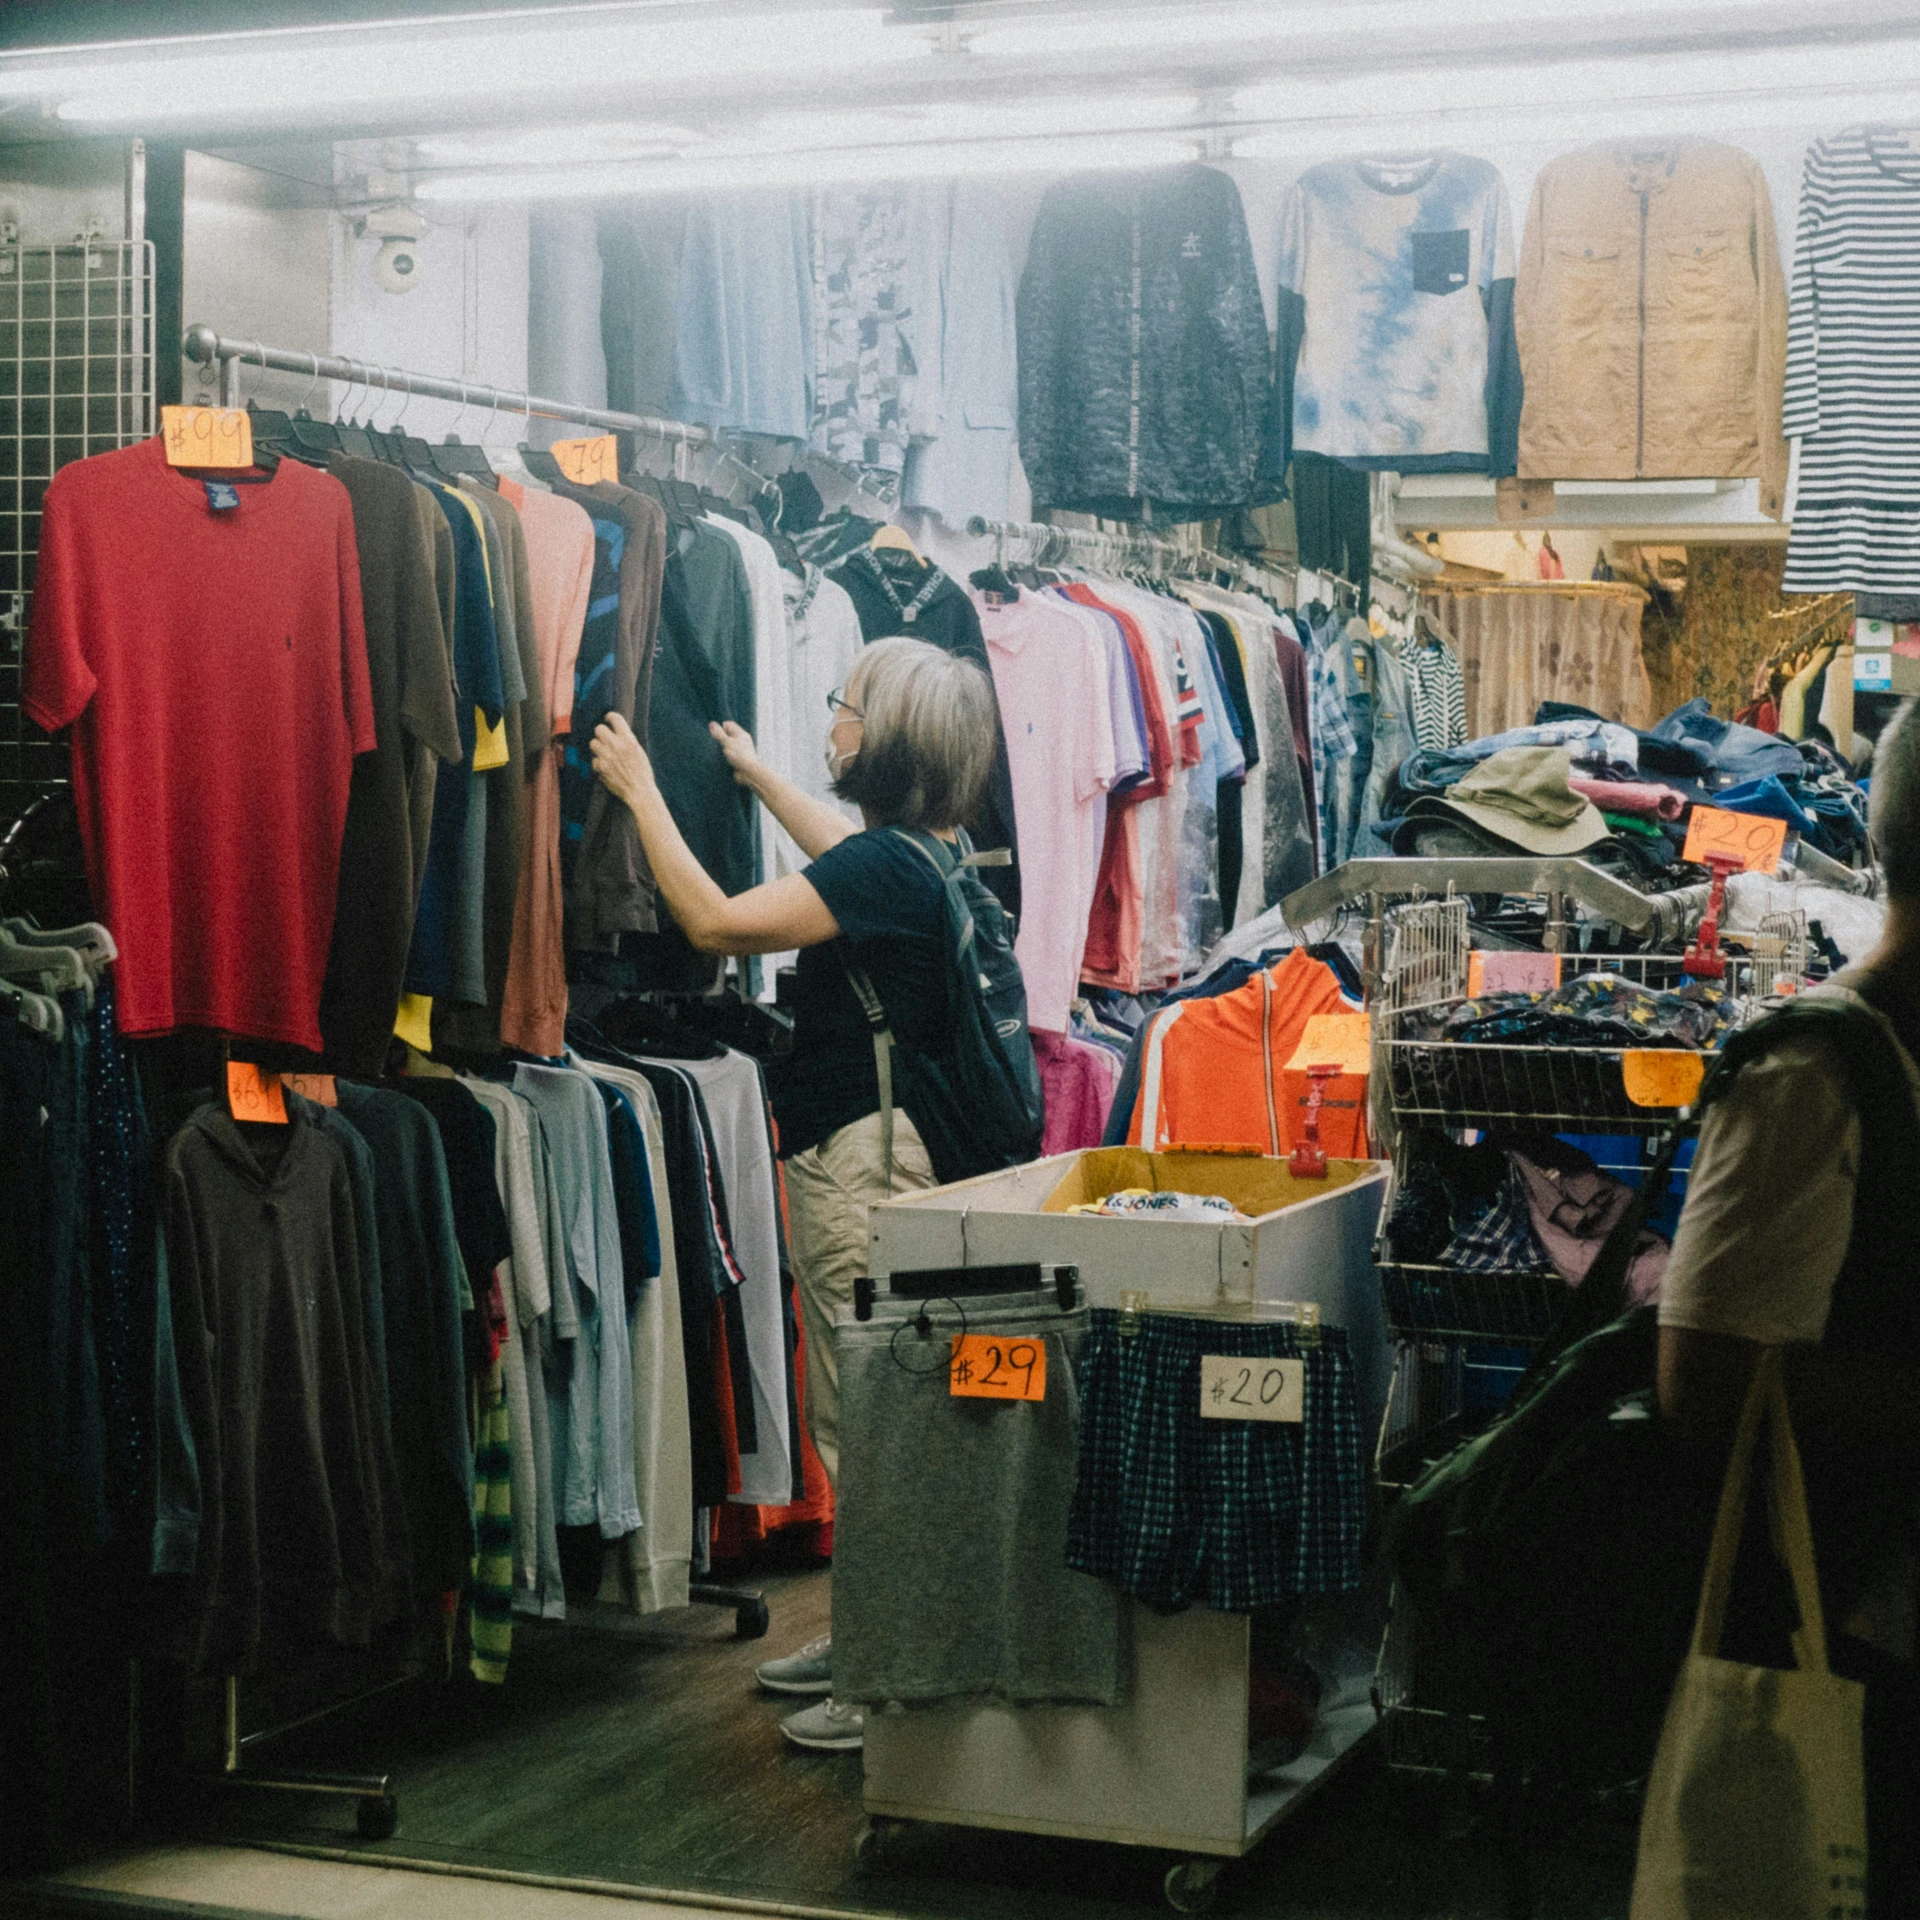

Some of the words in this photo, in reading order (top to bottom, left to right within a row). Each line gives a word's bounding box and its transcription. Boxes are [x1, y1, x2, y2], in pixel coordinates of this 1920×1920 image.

[170, 410, 243, 465] $99
[951, 1344, 1037, 1396] $29
[1211, 1368, 1284, 1406] $20
